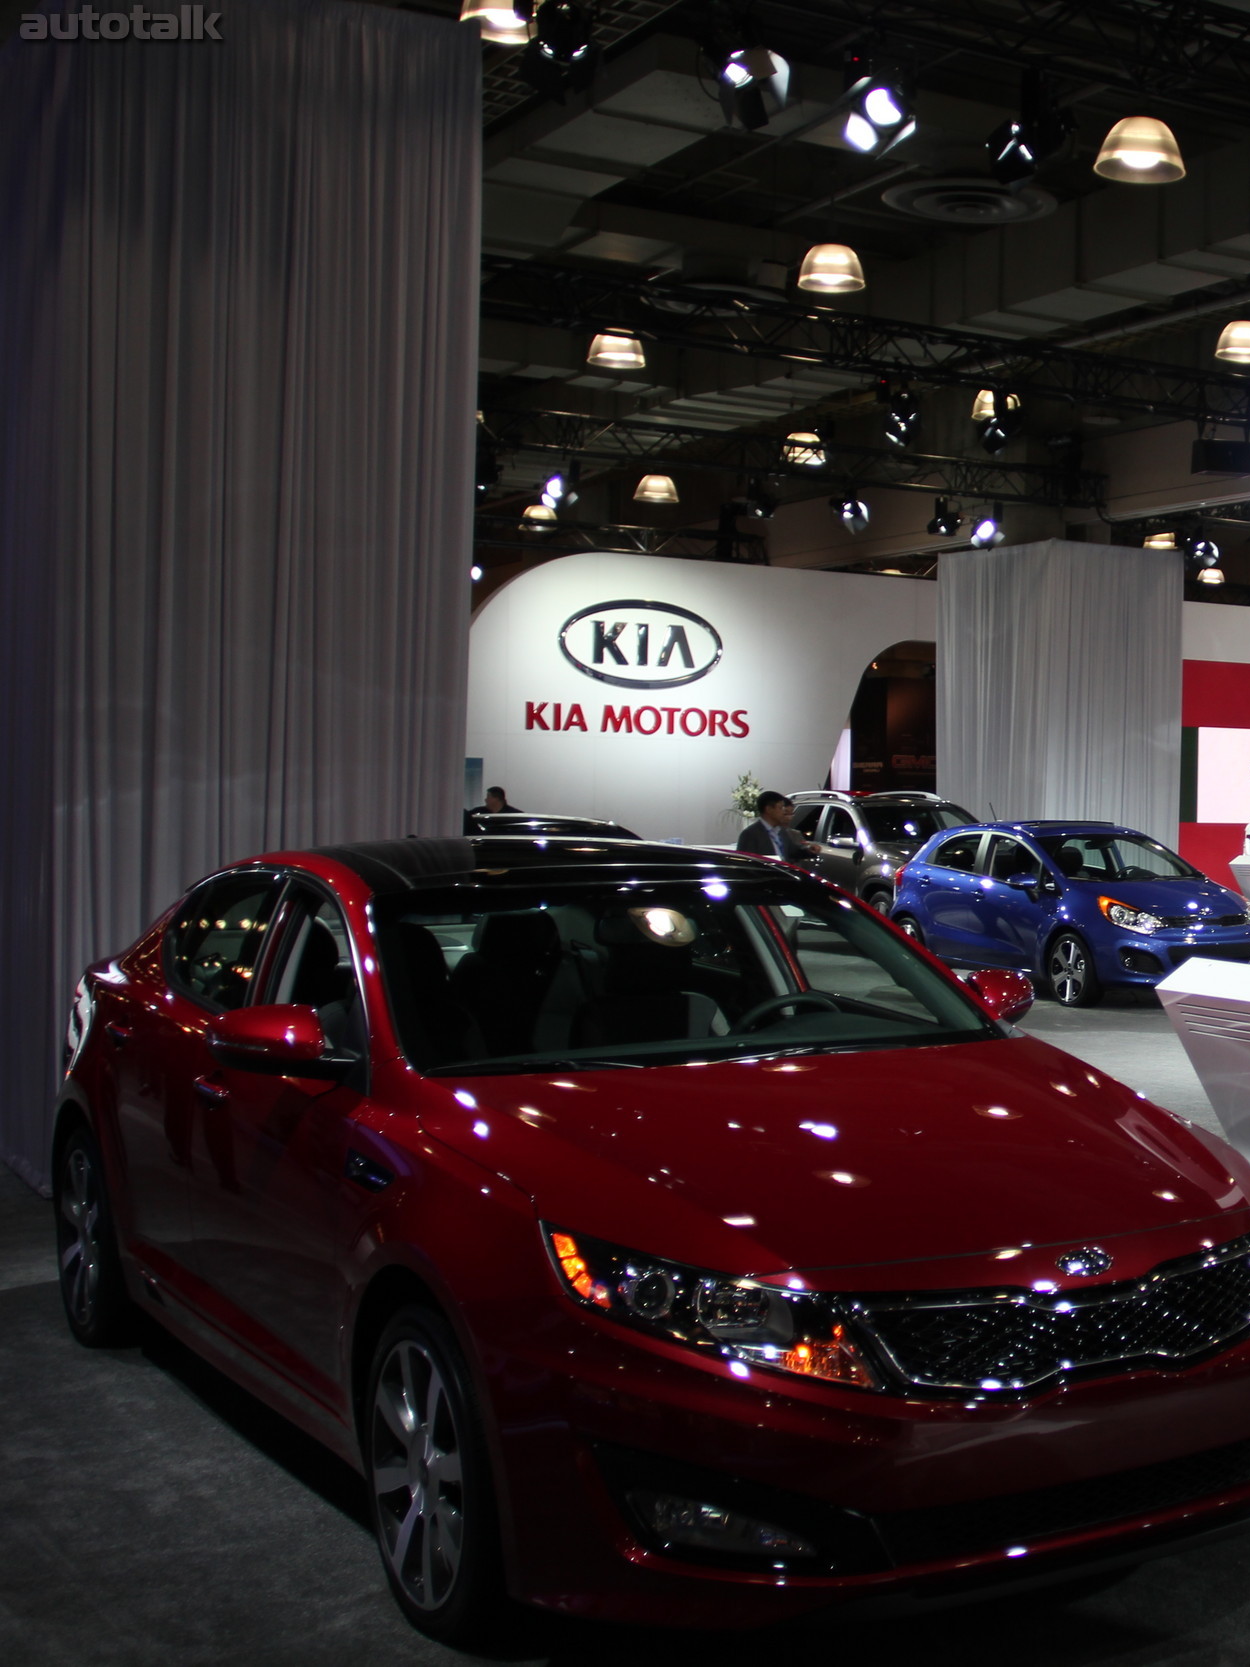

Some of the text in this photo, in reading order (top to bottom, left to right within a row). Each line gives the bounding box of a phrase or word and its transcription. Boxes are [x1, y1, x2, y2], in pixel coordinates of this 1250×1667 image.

[591, 620, 695, 669] KIA
[525, 701, 750, 739] KIA MOTORS
